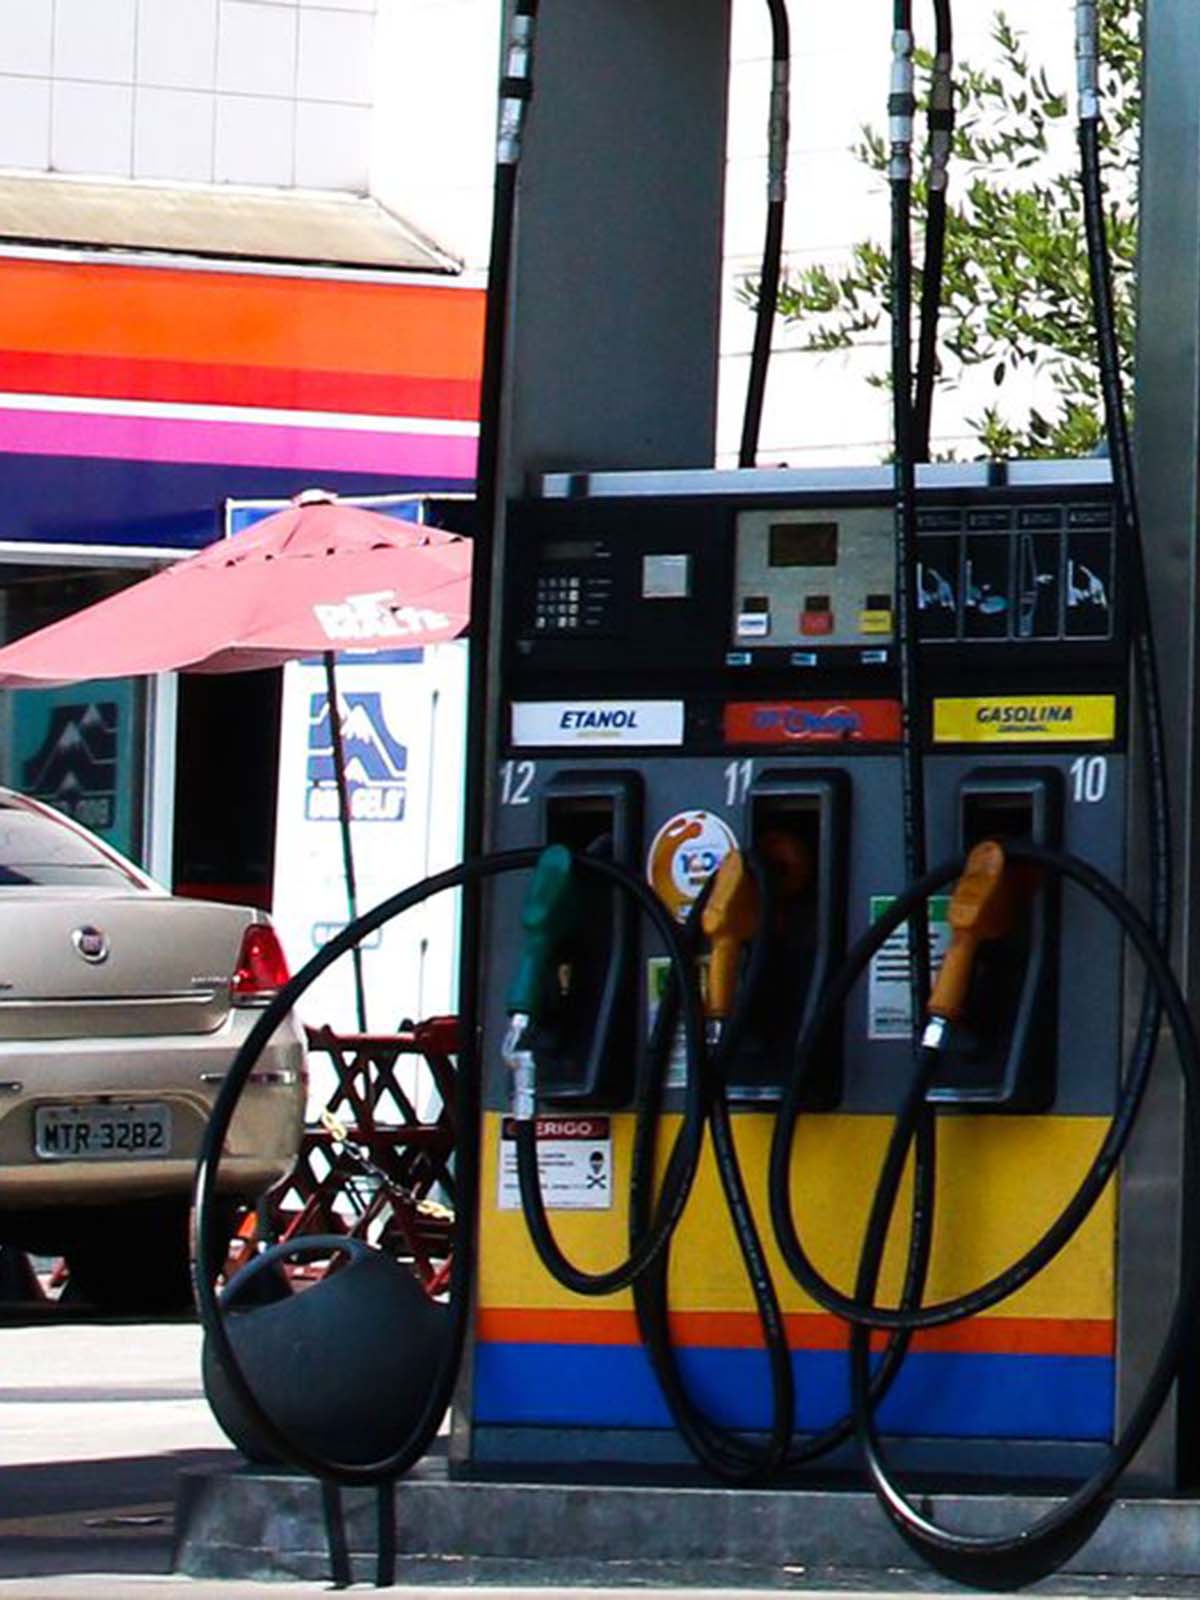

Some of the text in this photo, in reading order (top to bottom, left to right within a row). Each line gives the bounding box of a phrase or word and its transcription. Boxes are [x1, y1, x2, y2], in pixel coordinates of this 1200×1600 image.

[559, 710, 638, 729] ETANOL
[976, 706, 1073, 724] GASOLINA
[499, 760, 536, 805] 12
[724, 758, 754, 806] 11
[1070, 755, 1108, 803] 10
[100, 1121, 163, 1150] 3282
[535, 1120, 592, 1136] ERIGO
